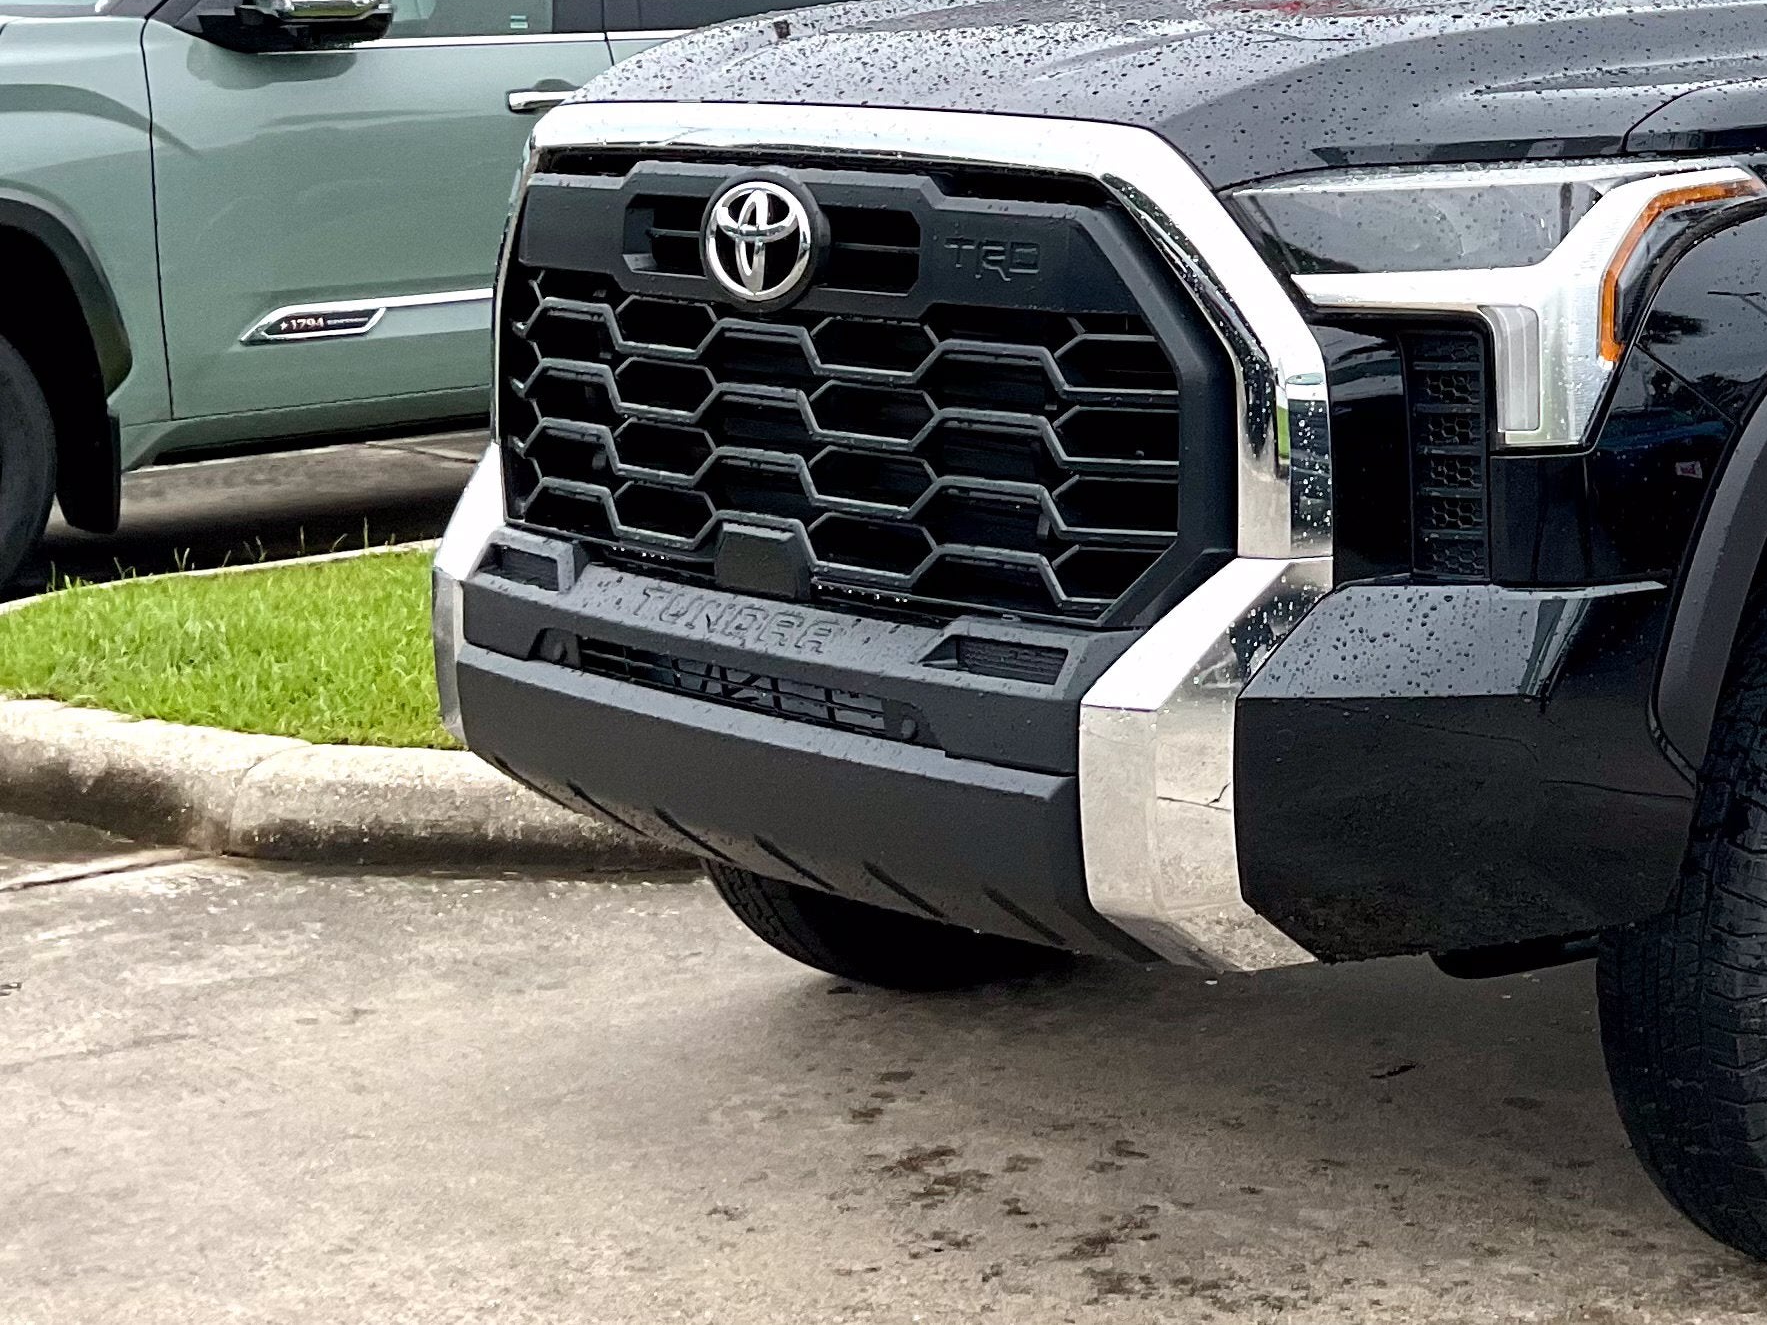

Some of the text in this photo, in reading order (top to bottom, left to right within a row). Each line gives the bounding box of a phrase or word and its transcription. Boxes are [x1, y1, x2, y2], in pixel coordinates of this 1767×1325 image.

[943, 238, 1040, 282] TRD
[291, 318, 325, 331] 1794
[633, 585, 842, 654] TUNDRA
